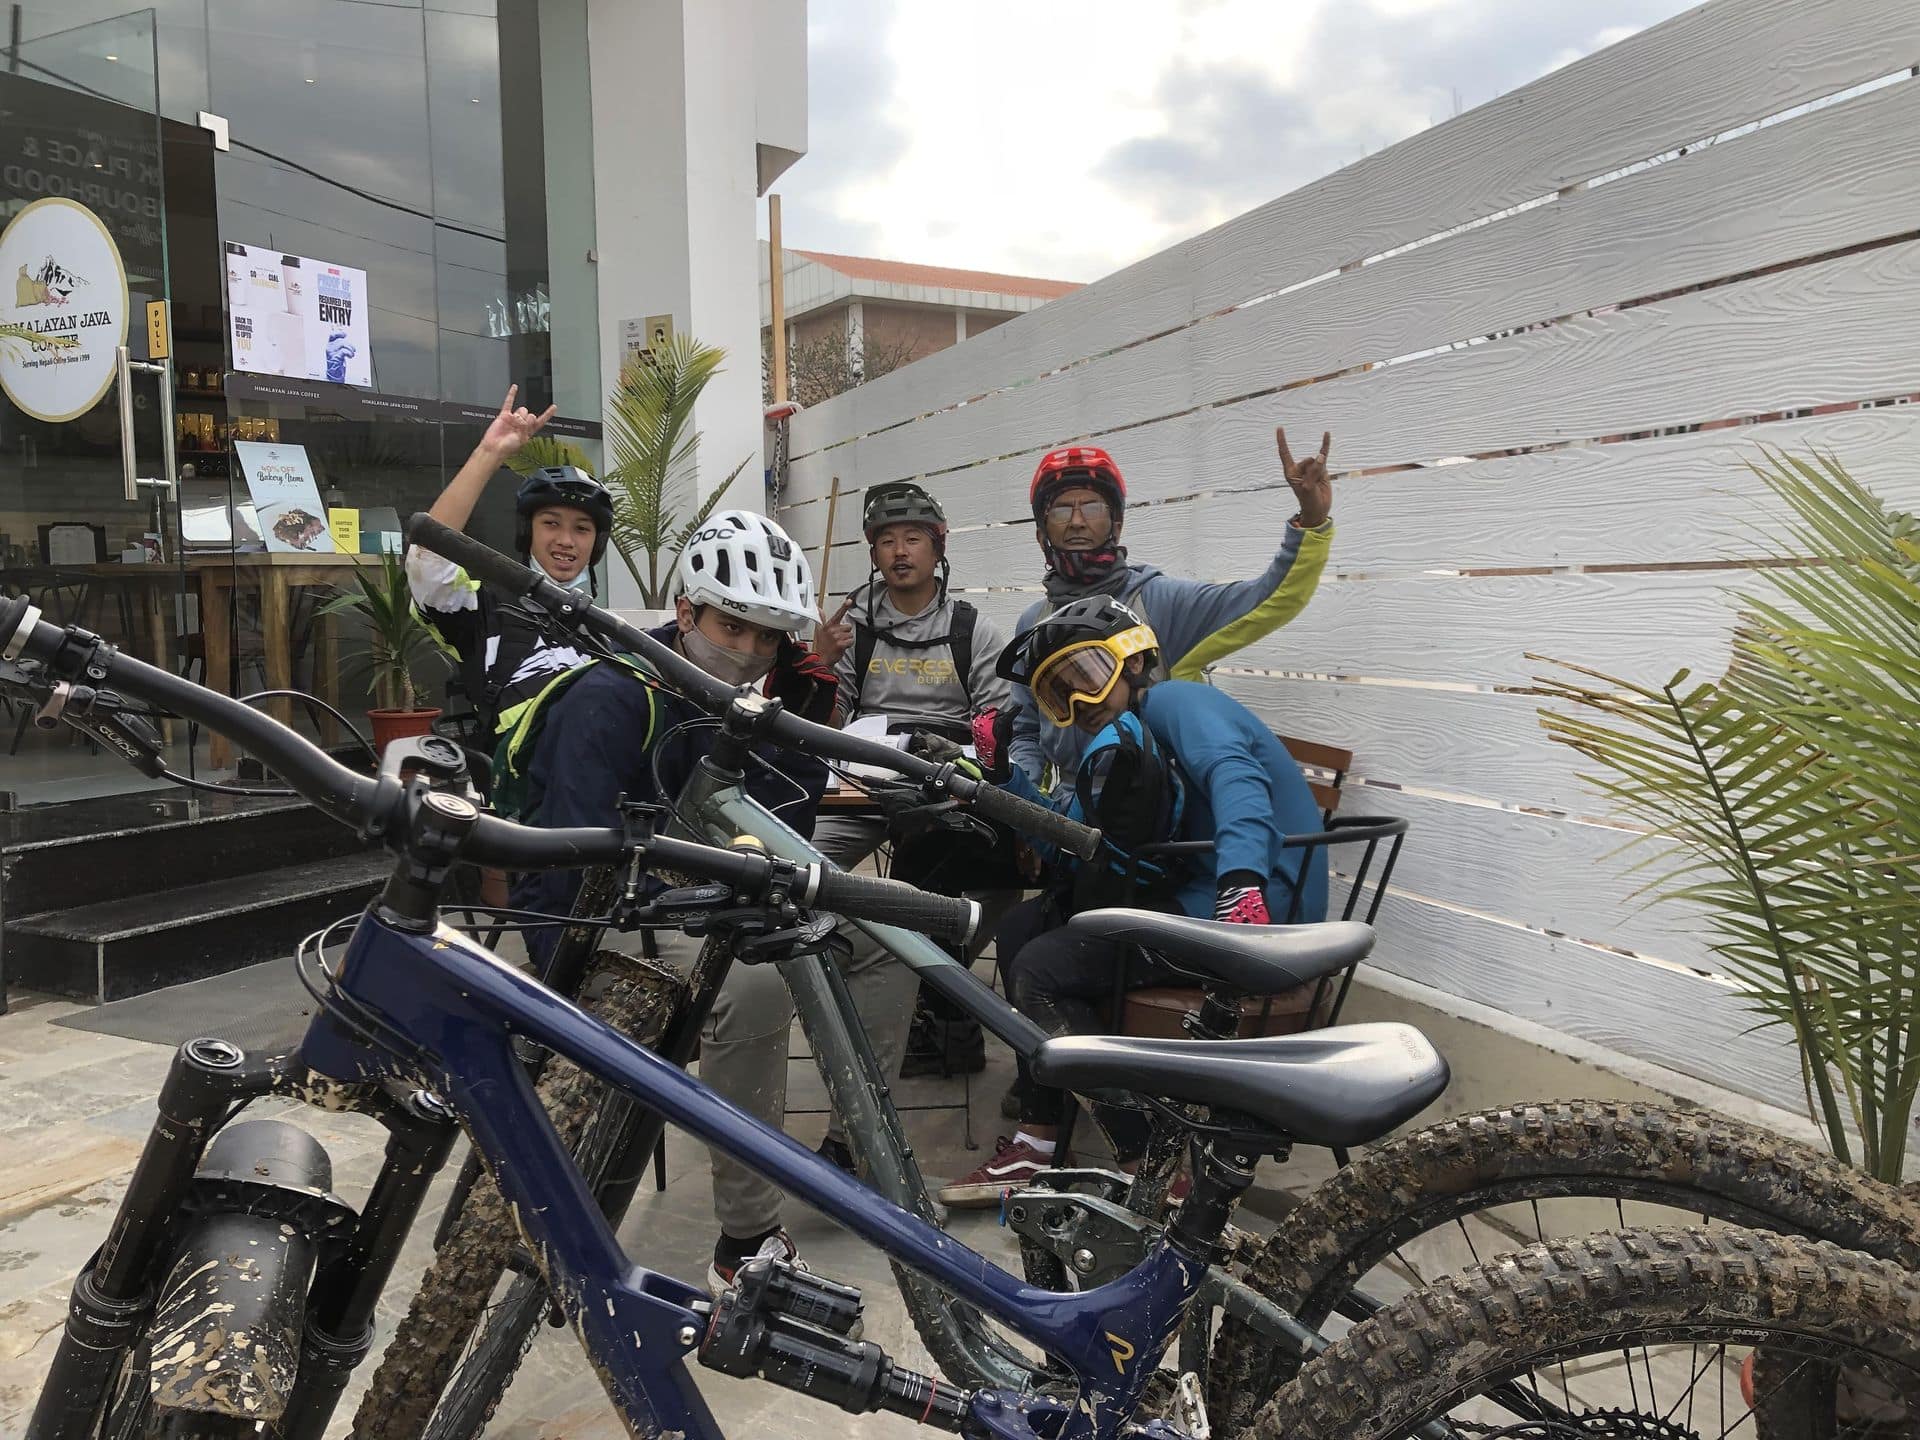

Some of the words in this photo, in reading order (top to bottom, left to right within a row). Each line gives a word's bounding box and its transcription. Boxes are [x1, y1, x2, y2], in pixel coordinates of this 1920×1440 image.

[319, 294, 342, 307] REQUIRED
[342, 299, 352, 309] FOR
[319, 303, 352, 326] ENTRY
[0, 314, 78, 334] MALAYAN
[80, 311, 112, 328] JAVA
[153, 310, 161, 349] PULL
[22, 360, 39, 369] Serving
[80, 353, 90, 362] 1999
[254, 385, 286, 395] HIMALAYAN
[301, 390, 321, 399] COFFEE
[361, 399, 389, 407] HIMALAYAN
[280, 465, 296, 474] OFF
[256, 471, 284, 486] Bakery
[284, 473, 304, 483] Items
[869, 659, 953, 677] EVERES
